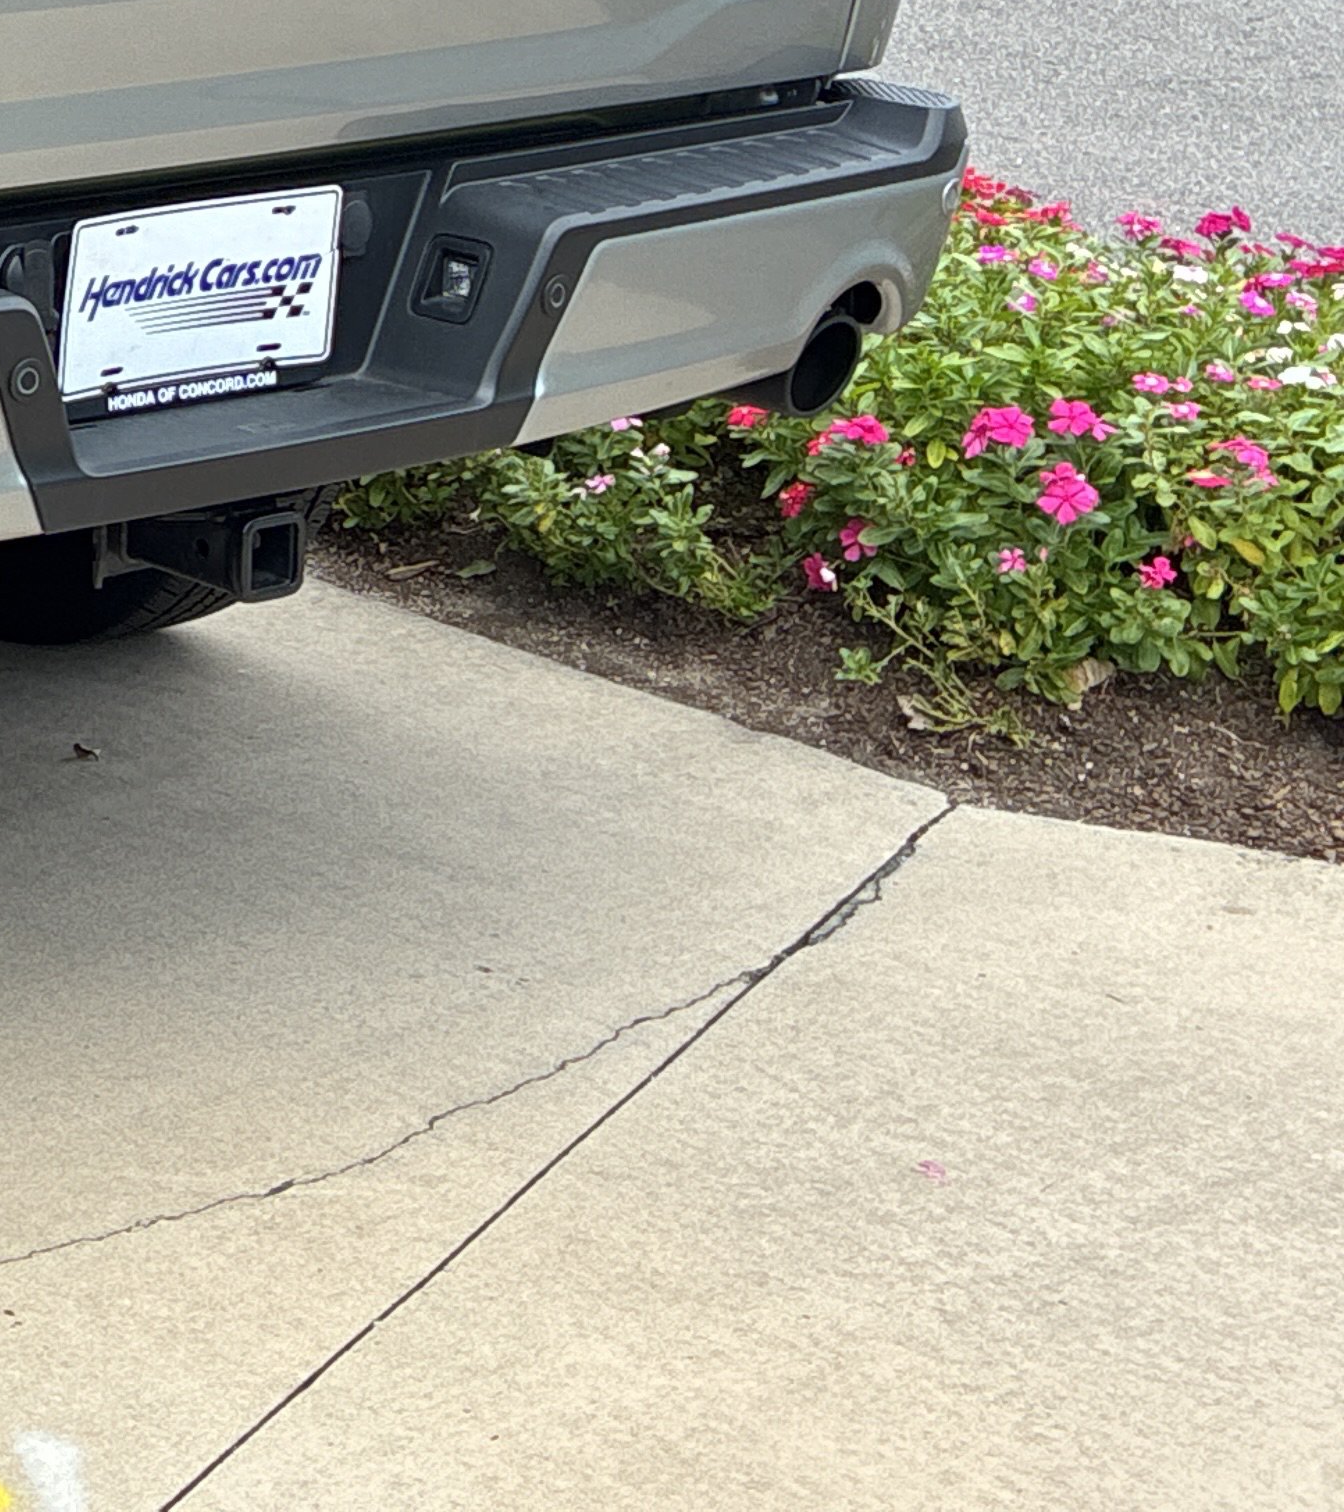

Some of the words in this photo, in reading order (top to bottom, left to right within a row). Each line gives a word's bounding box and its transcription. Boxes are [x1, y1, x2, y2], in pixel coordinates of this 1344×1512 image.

[107, 390, 156, 412] HONDA
[157, 386, 177, 404] OF
[178, 371, 278, 400] CONCORD.COM
